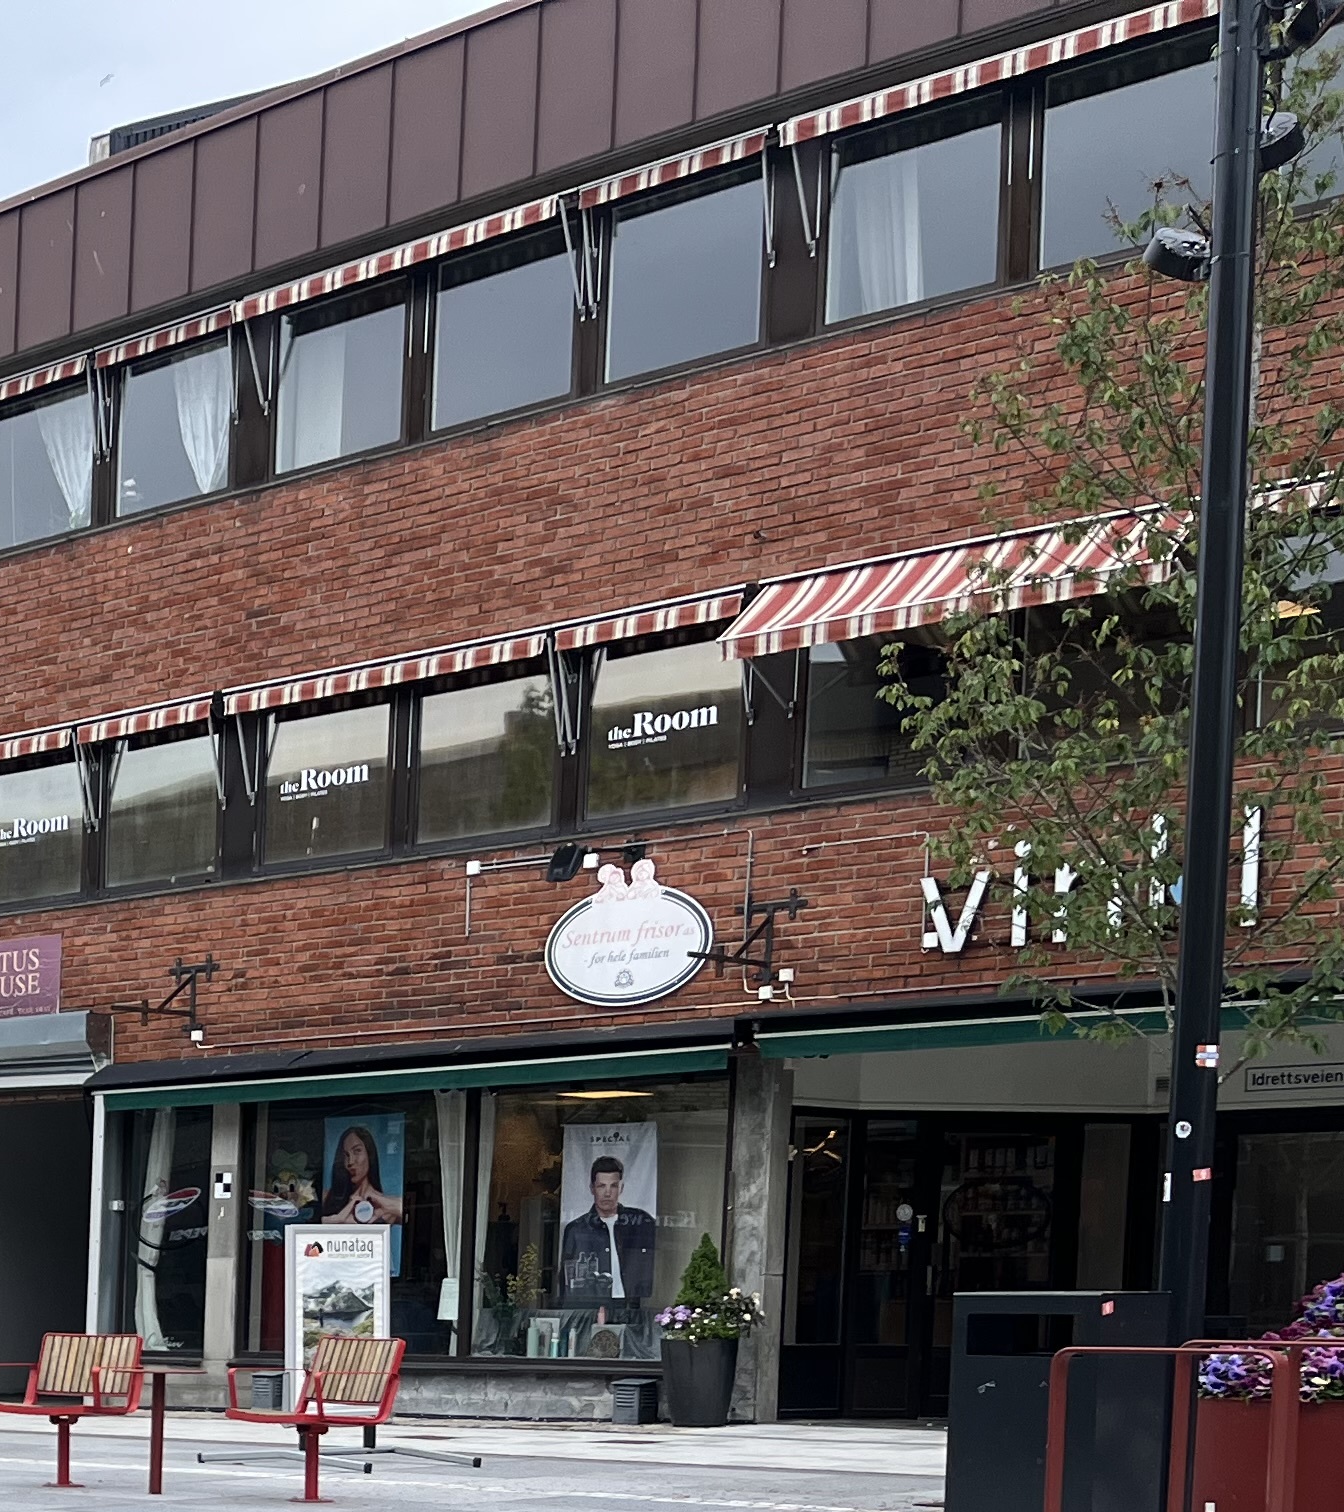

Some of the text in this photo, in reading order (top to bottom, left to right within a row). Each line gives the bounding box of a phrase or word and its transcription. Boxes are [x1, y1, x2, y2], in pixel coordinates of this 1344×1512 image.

[562, 929, 631, 948] Sentrum
[587, 951, 606, 968] for
[626, 947, 670, 965] familien
[1252, 1069, 1343, 1087] Idrettsveien
[327, 1238, 373, 1259] nunataq
